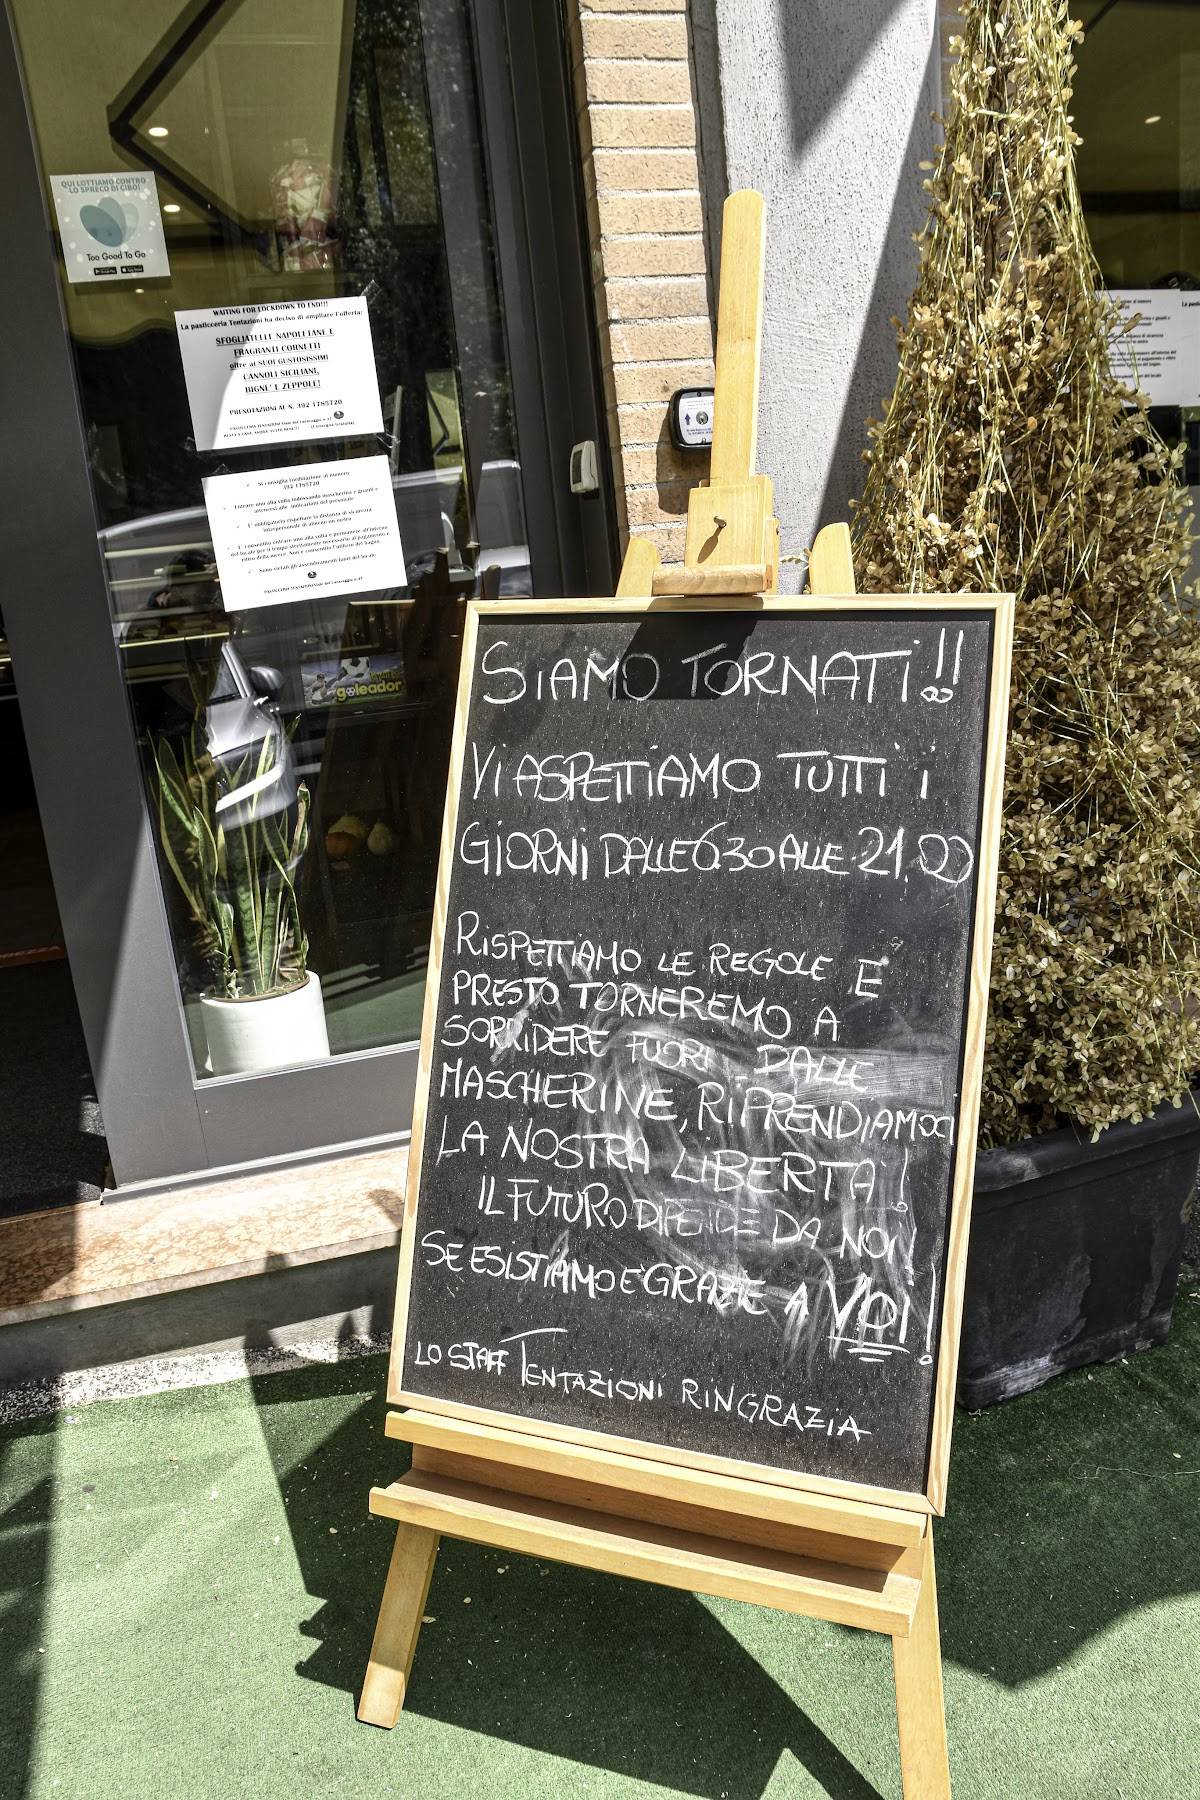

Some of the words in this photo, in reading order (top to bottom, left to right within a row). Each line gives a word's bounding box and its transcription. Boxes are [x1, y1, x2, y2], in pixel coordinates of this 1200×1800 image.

[61, 180, 75, 188] QUI
[76, 178, 114, 187] LOTTIAMO
[115, 177, 146, 185] CONTRO
[81, 185, 109, 193] SPRECO
[86, 253, 100, 261] Too
[102, 251, 122, 260] Good
[124, 251, 133, 259] To
[134, 250, 146, 258] Go
[191, 320, 227, 330] pasticceria
[228, 318, 263, 326] Tentazioni
[212, 308, 241, 316] WAITING
[257, 303, 295, 313] LOCKDOWN
[229, 362, 247, 370] oltre
[233, 346, 279, 357] FRAGRANTI
[243, 371, 278, 380] CANNOLI
[336, 680, 402, 703] goleador
[482, 641, 660, 704] SIAMO
[473, 742, 506, 800] VI
[513, 745, 761, 803] ASPETTIAMO
[777, 742, 900, 797] TUTTI
[461, 821, 588, 880] GIORNI
[456, 911, 642, 975] RISPETTIAMO
[657, 952, 696, 976] LE
[709, 943, 833, 981] REGOLE
[453, 970, 560, 1006] PRESTO
[569, 981, 791, 1039] TORNEREMO
[815, 1006, 840, 1041] A
[626, 1031, 714, 1073] FUORI
[754, 1044, 874, 1092] DALLE
[436, 1115, 489, 1165] LA
[501, 1118, 649, 1174] NOSTRA
[478, 1175, 504, 1215] IL
[507, 1179, 627, 1229] FUTURO
[773, 1209, 822, 1250] DA
[421, 1230, 463, 1272] SE
[471, 1245, 615, 1299] ESISTIAMO
[414, 1341, 441, 1365] LO
[448, 1342, 509, 1375] STAFF
[499, 1327, 663, 1401] TENTAZIONI
[682, 1378, 872, 1442] RINGRAZIA
